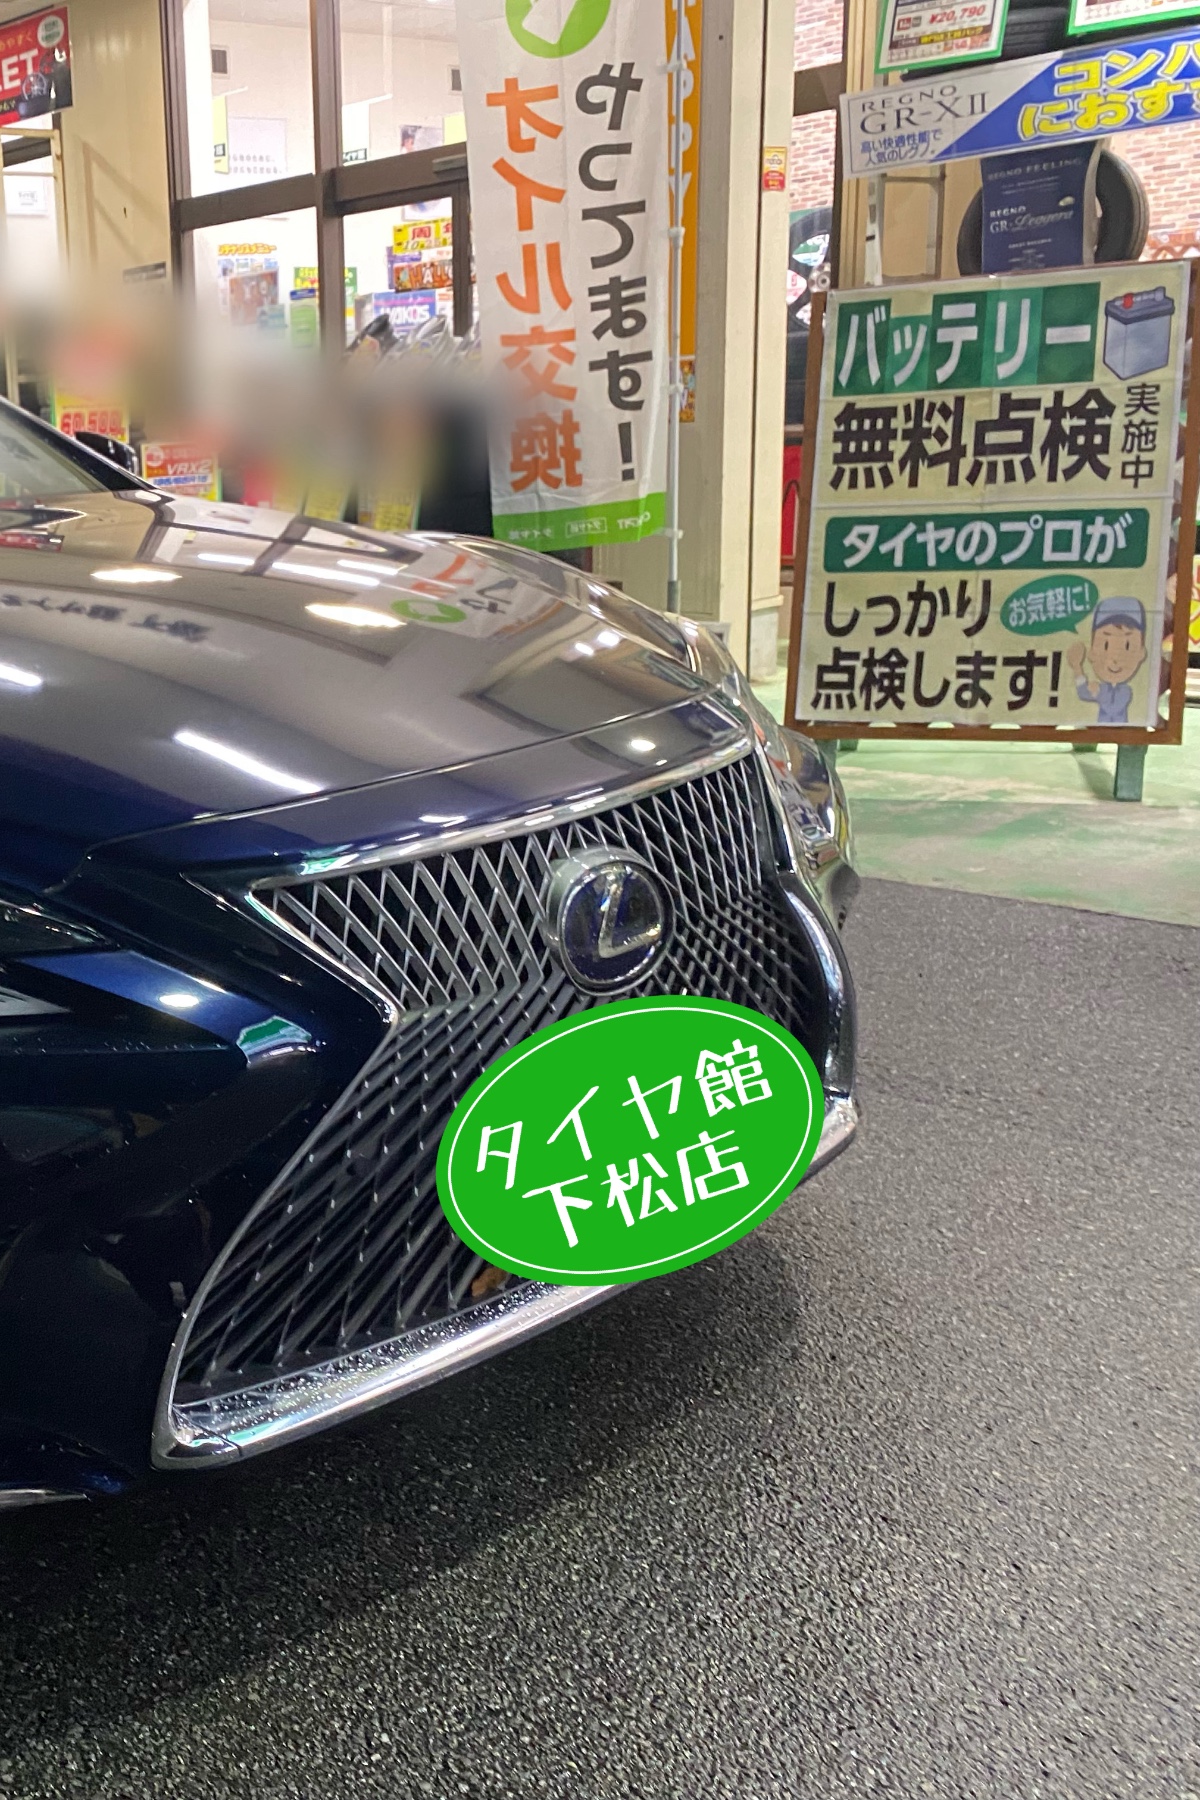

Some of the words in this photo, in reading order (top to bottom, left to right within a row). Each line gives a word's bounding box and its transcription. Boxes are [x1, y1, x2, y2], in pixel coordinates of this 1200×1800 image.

[667, 0, 697, 221] APPY
[861, 84, 958, 113] REGNO
[1019, 79, 1200, 140] におす
[860, 128, 944, 154] 高い快適性能で
[838, 297, 1093, 388] バッテリー
[829, 388, 1117, 491] 無料点検
[1120, 383, 1161, 489] 実施中
[842, 511, 1134, 570] タイヤのプロが
[823, 579, 993, 638] しっかり
[810, 646, 1063, 712] 点検します!
